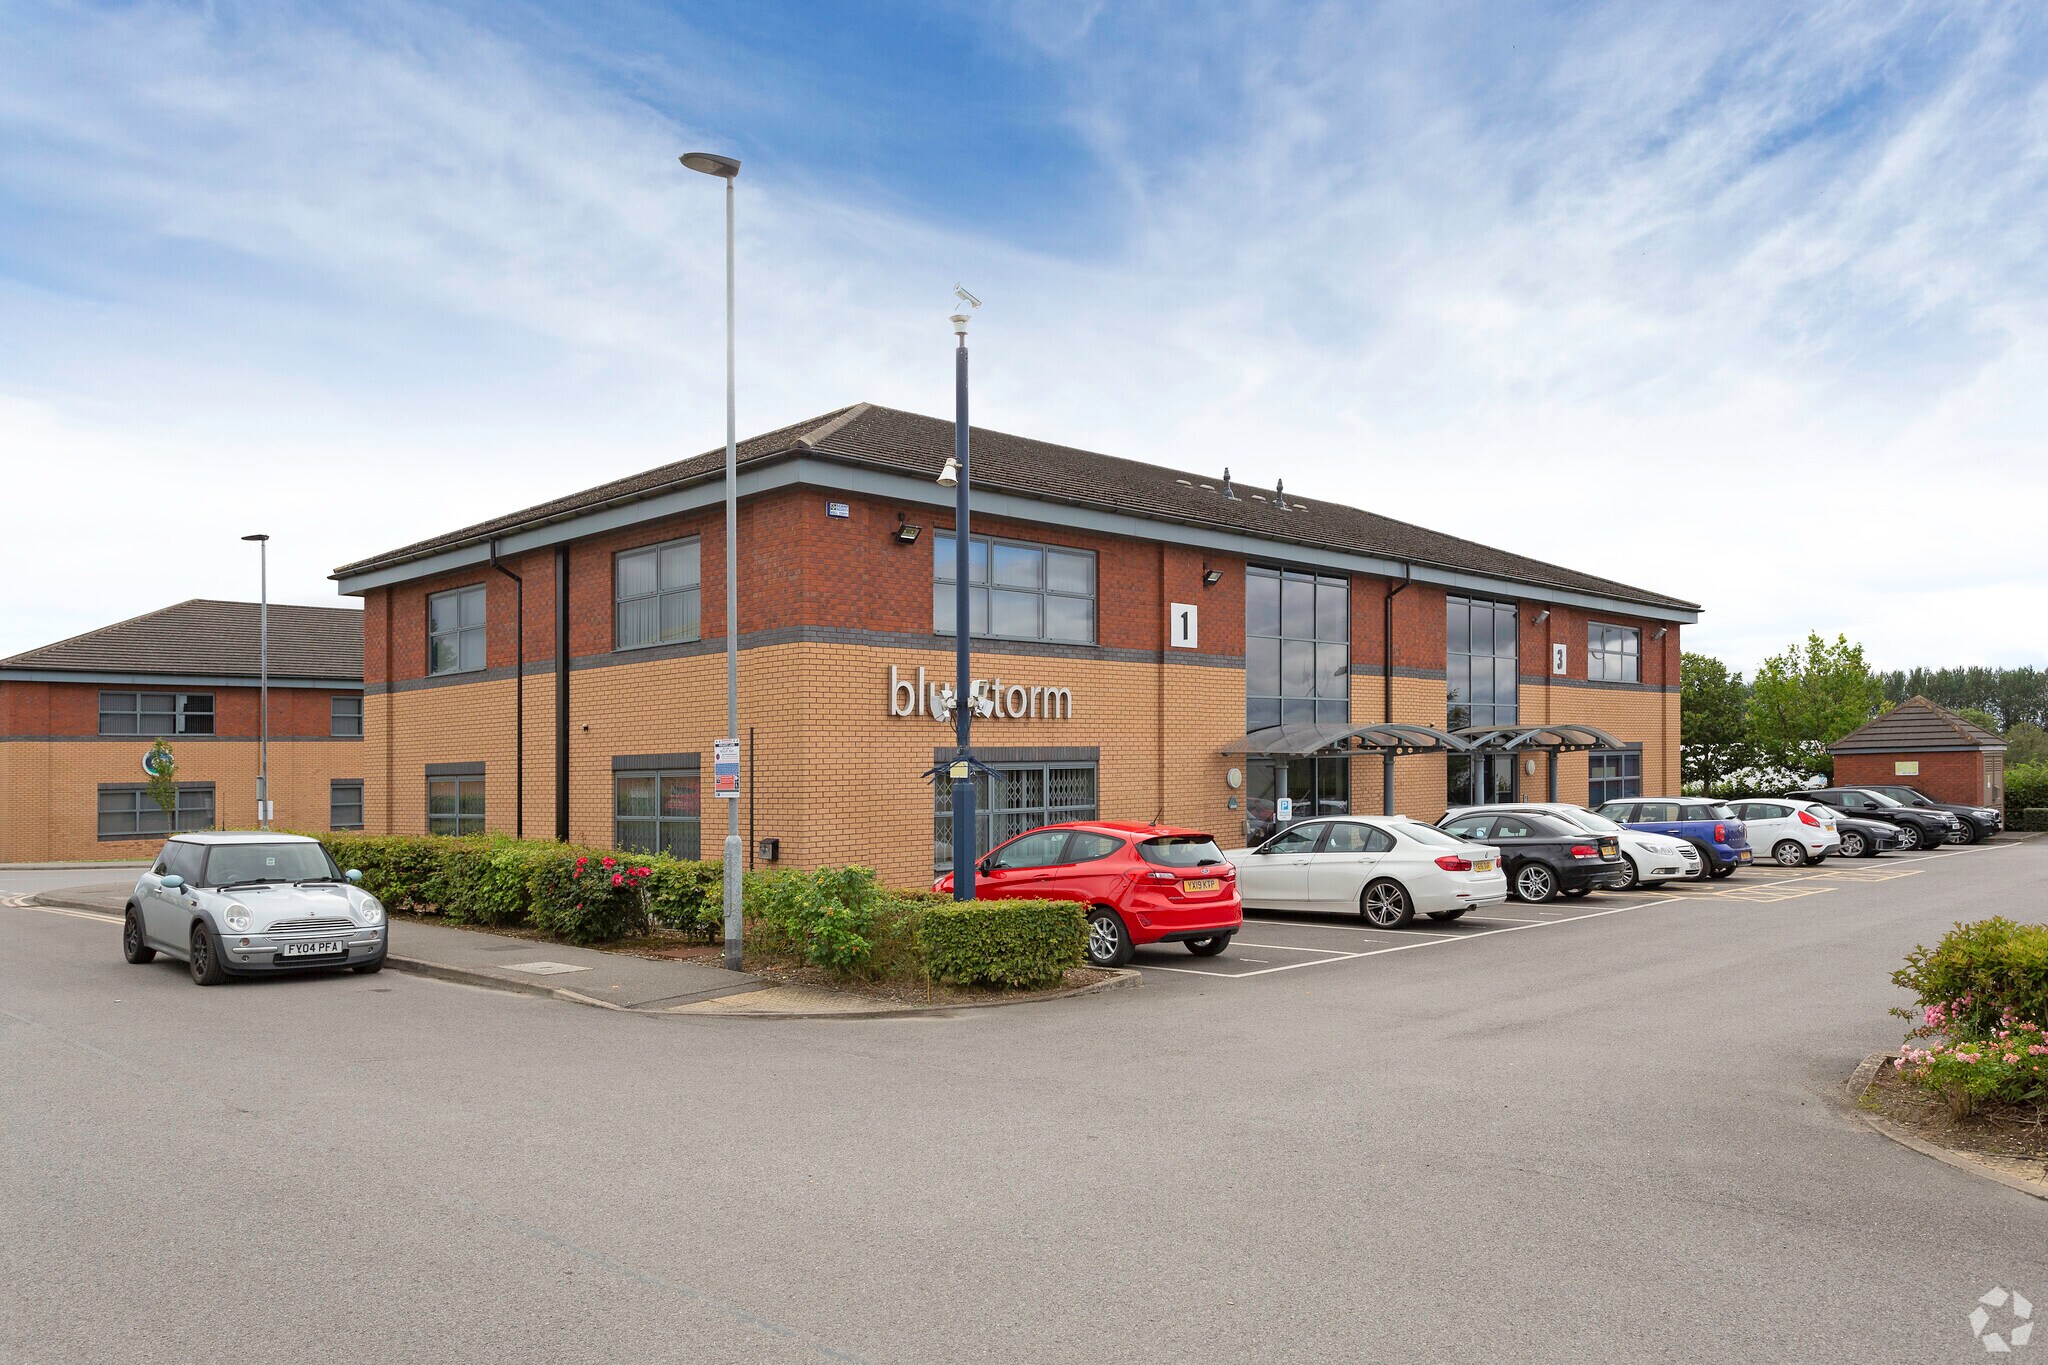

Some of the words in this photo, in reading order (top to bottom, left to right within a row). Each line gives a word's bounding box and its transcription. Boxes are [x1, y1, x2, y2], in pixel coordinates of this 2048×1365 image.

[1181, 611, 1188, 640] 1
[1557, 648, 1563, 670] 3
[1187, 880, 1202, 890] YX19
[1202, 879, 1215, 889] KTP
[288, 943, 316, 954] FY04
[318, 942, 338, 952] PFA
